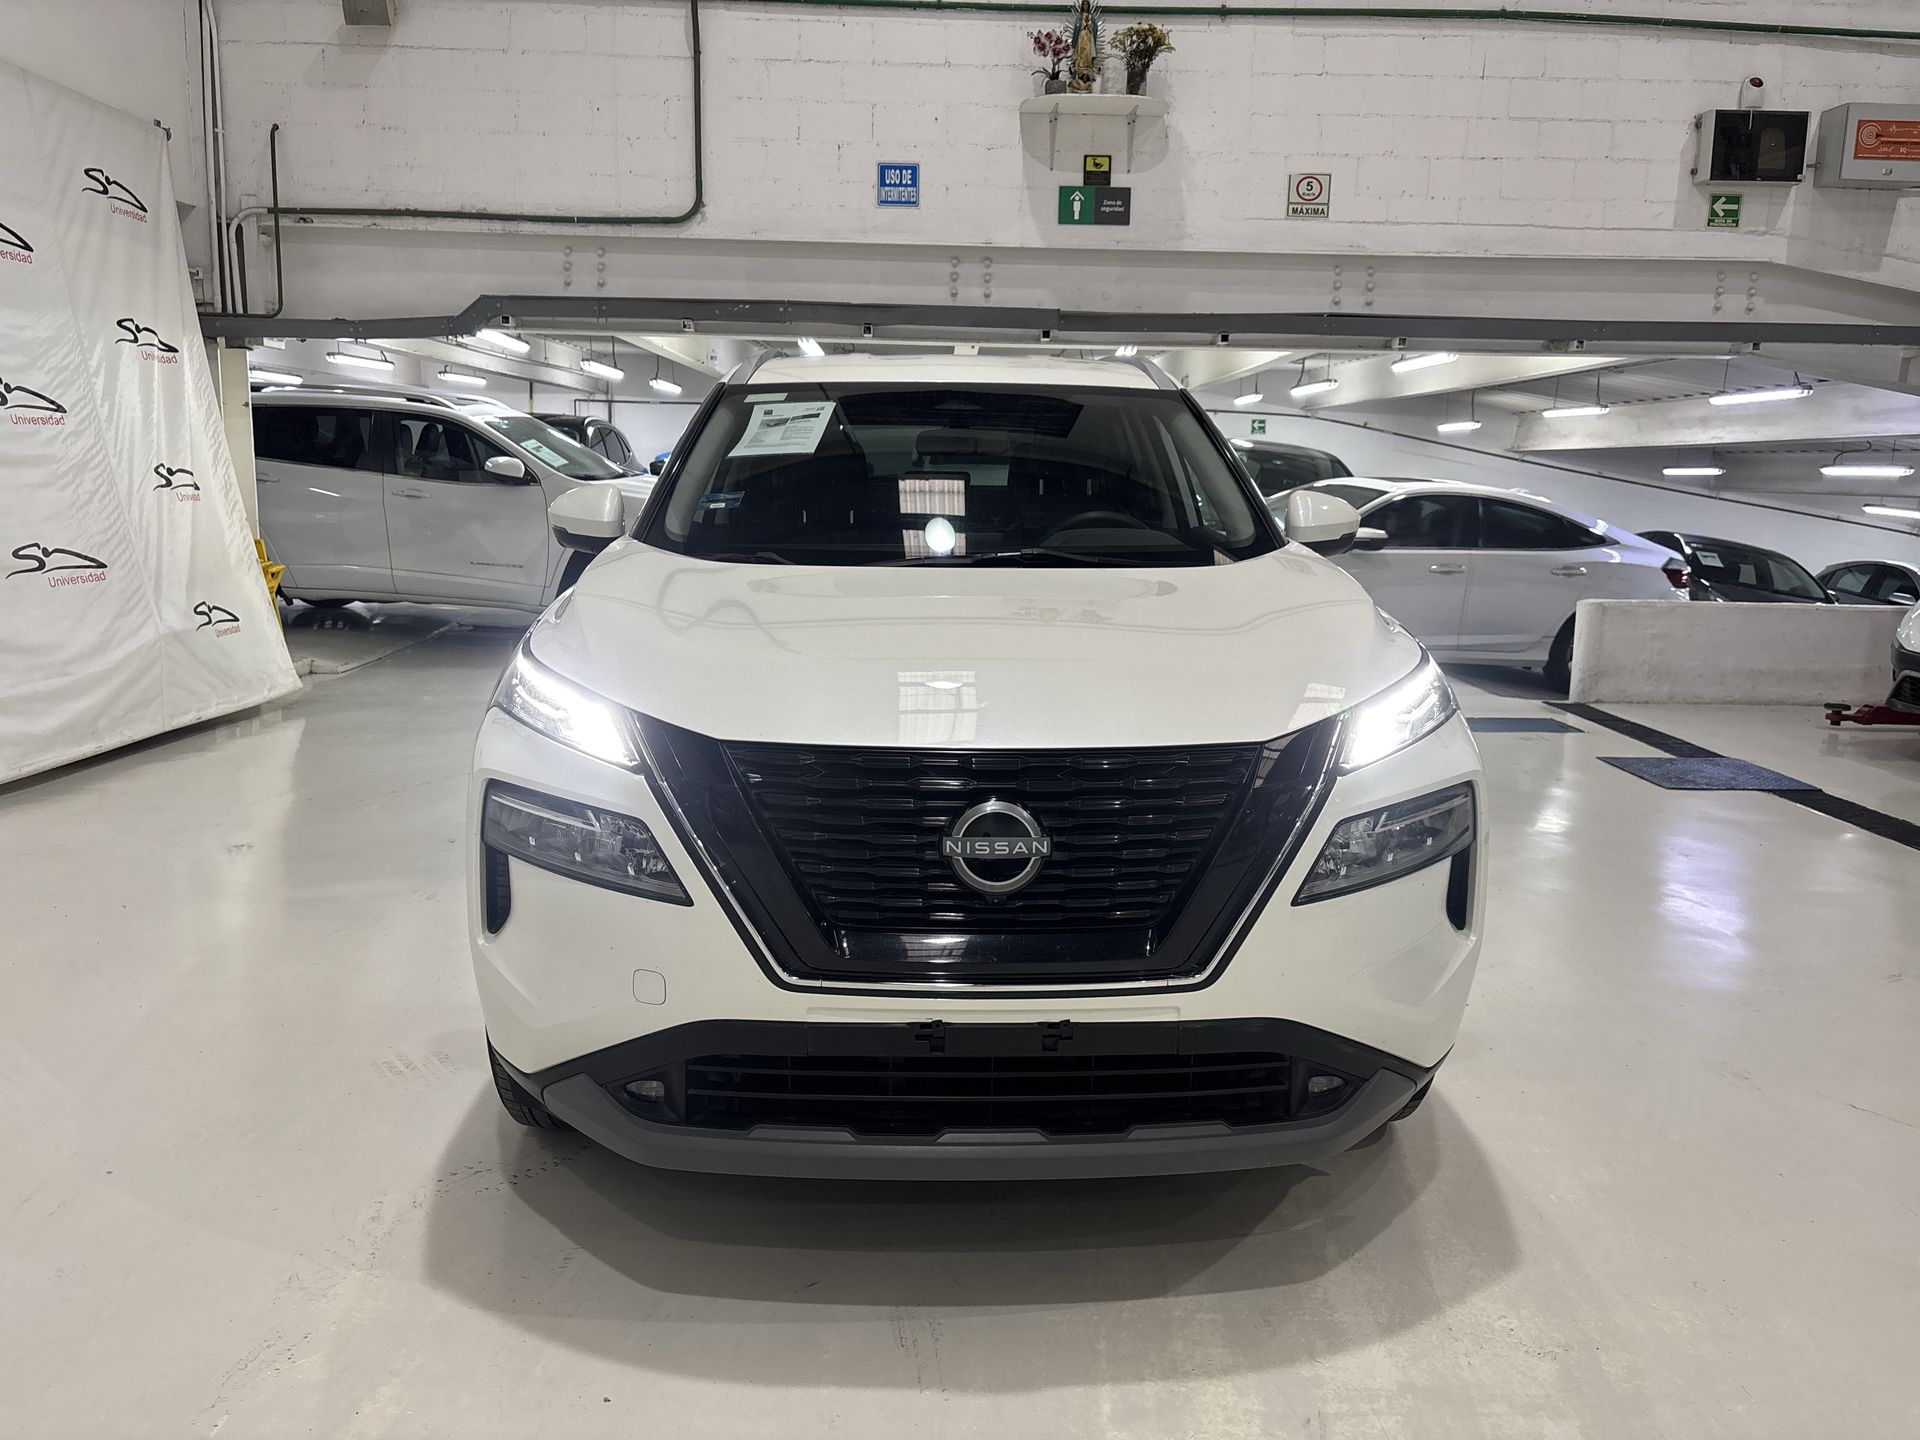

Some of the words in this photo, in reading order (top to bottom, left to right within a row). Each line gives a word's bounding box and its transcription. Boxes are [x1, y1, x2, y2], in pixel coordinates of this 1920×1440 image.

[885, 169, 900, 185] USO
[902, 169, 912, 185] DE
[1306, 181, 1314, 191] 5
[110, 203, 148, 224] Universidad
[1291, 205, 1326, 216] MÁXIMA
[10, 414, 66, 426] Universidad
[48, 570, 107, 588] Universidad
[946, 840, 1047, 855] NISSAN
